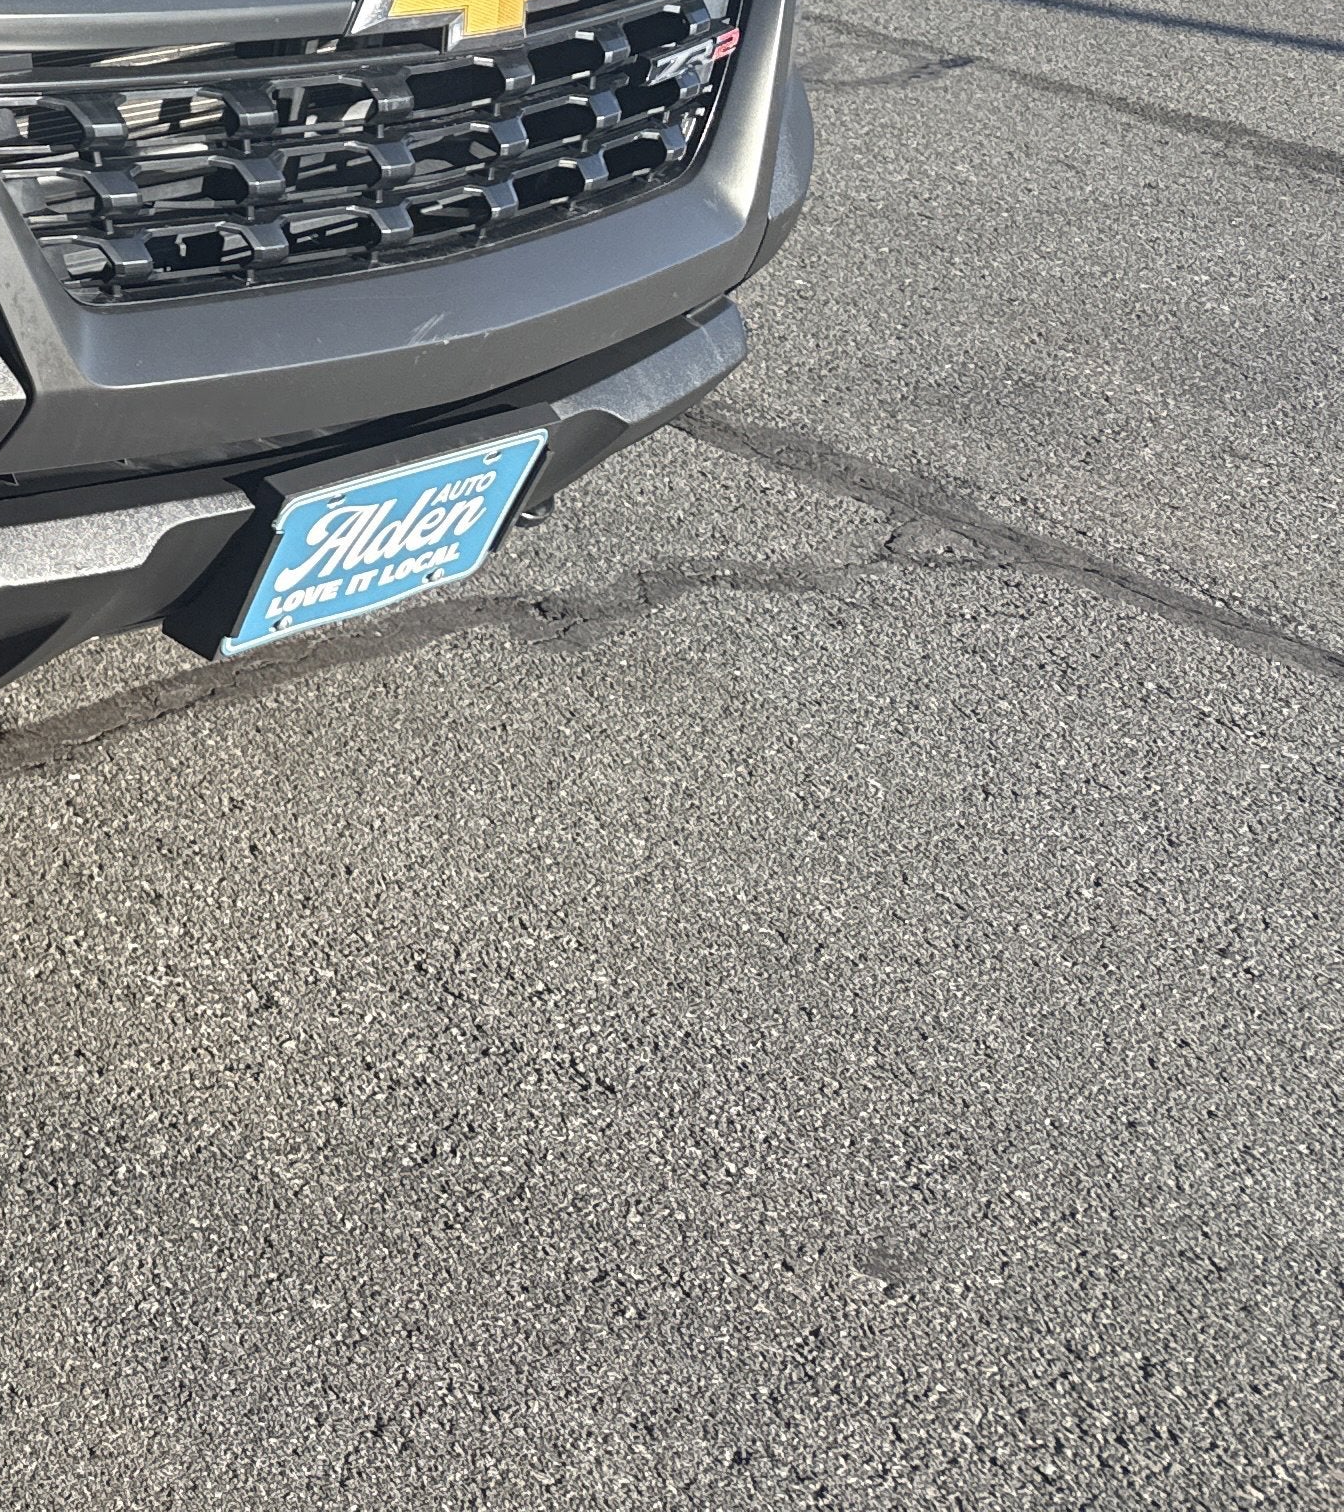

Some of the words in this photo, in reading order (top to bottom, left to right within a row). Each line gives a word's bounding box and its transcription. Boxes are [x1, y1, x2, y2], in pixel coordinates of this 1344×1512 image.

[645, 27, 740, 86] ZR2
[435, 470, 497, 505] AUTO
[274, 486, 486, 593] Alden
[267, 579, 342, 618] LOVE
[346, 571, 378, 593] IT
[379, 543, 460, 585] LOCAL
